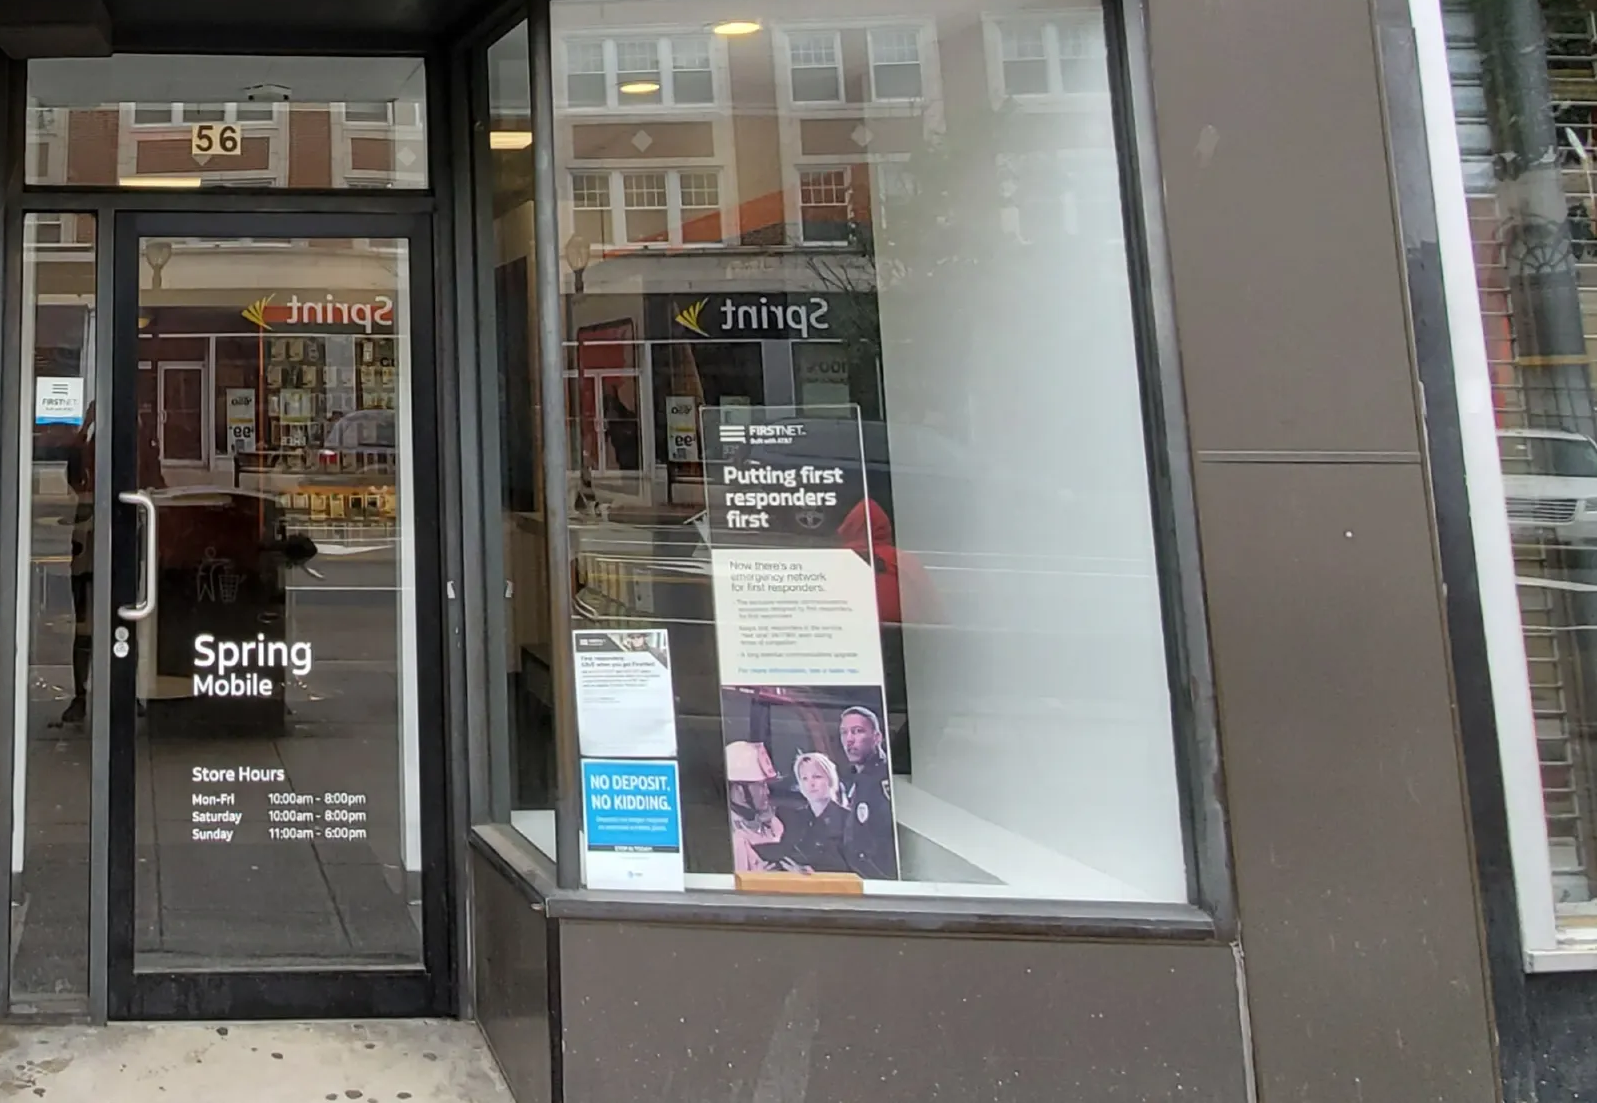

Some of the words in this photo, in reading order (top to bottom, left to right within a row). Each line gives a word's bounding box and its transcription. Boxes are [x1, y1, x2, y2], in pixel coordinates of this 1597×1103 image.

[194, 124, 240, 152] 56
[723, 466, 797, 488] Putting
[799, 466, 844, 484] first
[725, 488, 837, 509] responders
[726, 510, 770, 528] first
[729, 561, 753, 571] Now
[754, 561, 788, 571] there's
[789, 563, 803, 571] an
[730, 573, 785, 584] emergency
[786, 572, 827, 582] network
[731, 583, 745, 592] for
[746, 583, 766, 592] first
[767, 583, 826, 594] responders.
[193, 633, 312, 675] Spring
[193, 673, 273, 697] Mobile
[192, 766, 235, 782] Store
[238, 766, 285, 782] Hours
[590, 774, 608, 790] NO
[611, 775, 671, 791] DEPOSIT.
[191, 793, 235, 806] Mon-Fri
[268, 793, 314, 805] 10:00am
[324, 793, 367, 808] 8:00pm
[591, 794, 610, 810] NO
[613, 795, 672, 811] KIDDING.
[191, 810, 243, 824] Saturday
[268, 811, 314, 822] 10:00am
[324, 811, 367, 825] 8:00pm
[191, 828, 234, 842] Sunday
[268, 828, 314, 839] 11:00am
[324, 828, 367, 842] 6:00pm
